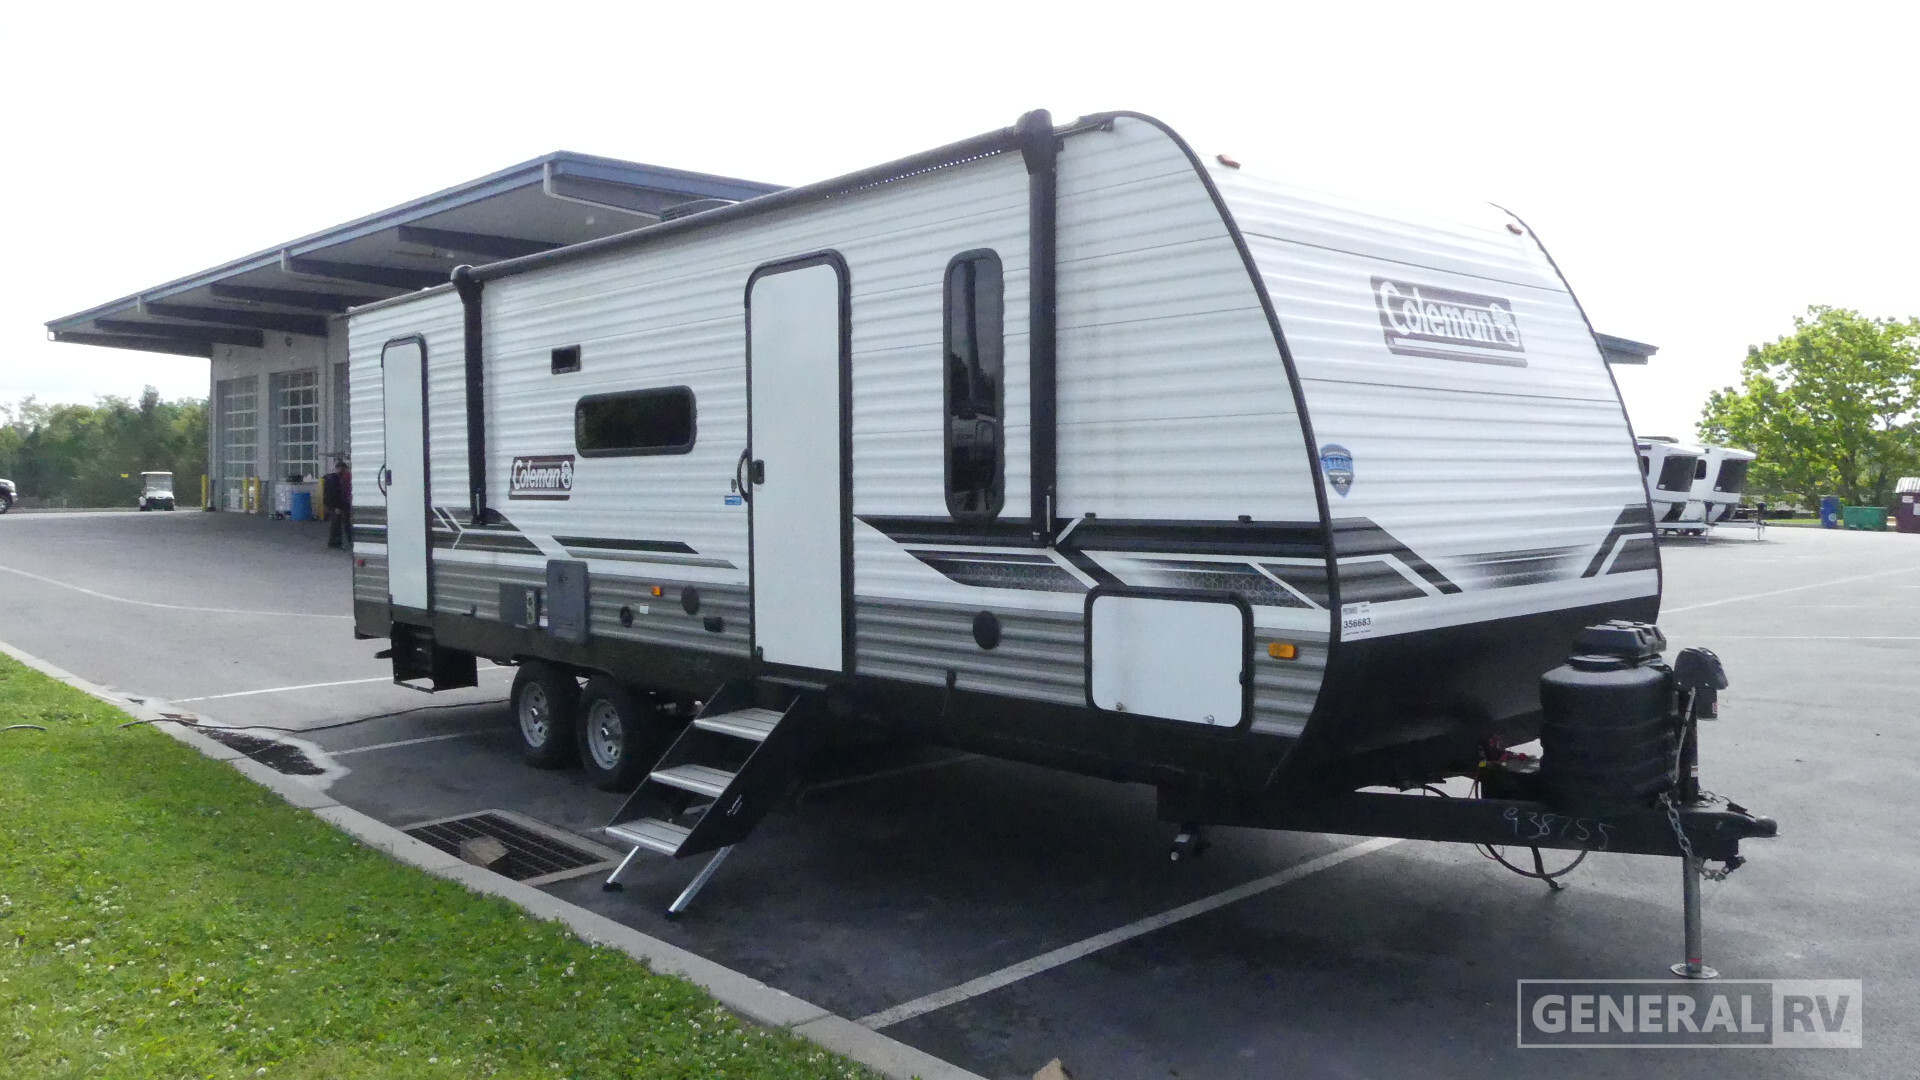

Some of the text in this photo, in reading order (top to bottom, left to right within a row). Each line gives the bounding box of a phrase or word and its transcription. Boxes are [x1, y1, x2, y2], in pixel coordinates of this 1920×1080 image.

[1380, 281, 1497, 342] Coleman
[513, 460, 561, 490] Coleman
[1343, 617, 1371, 629] 356683
